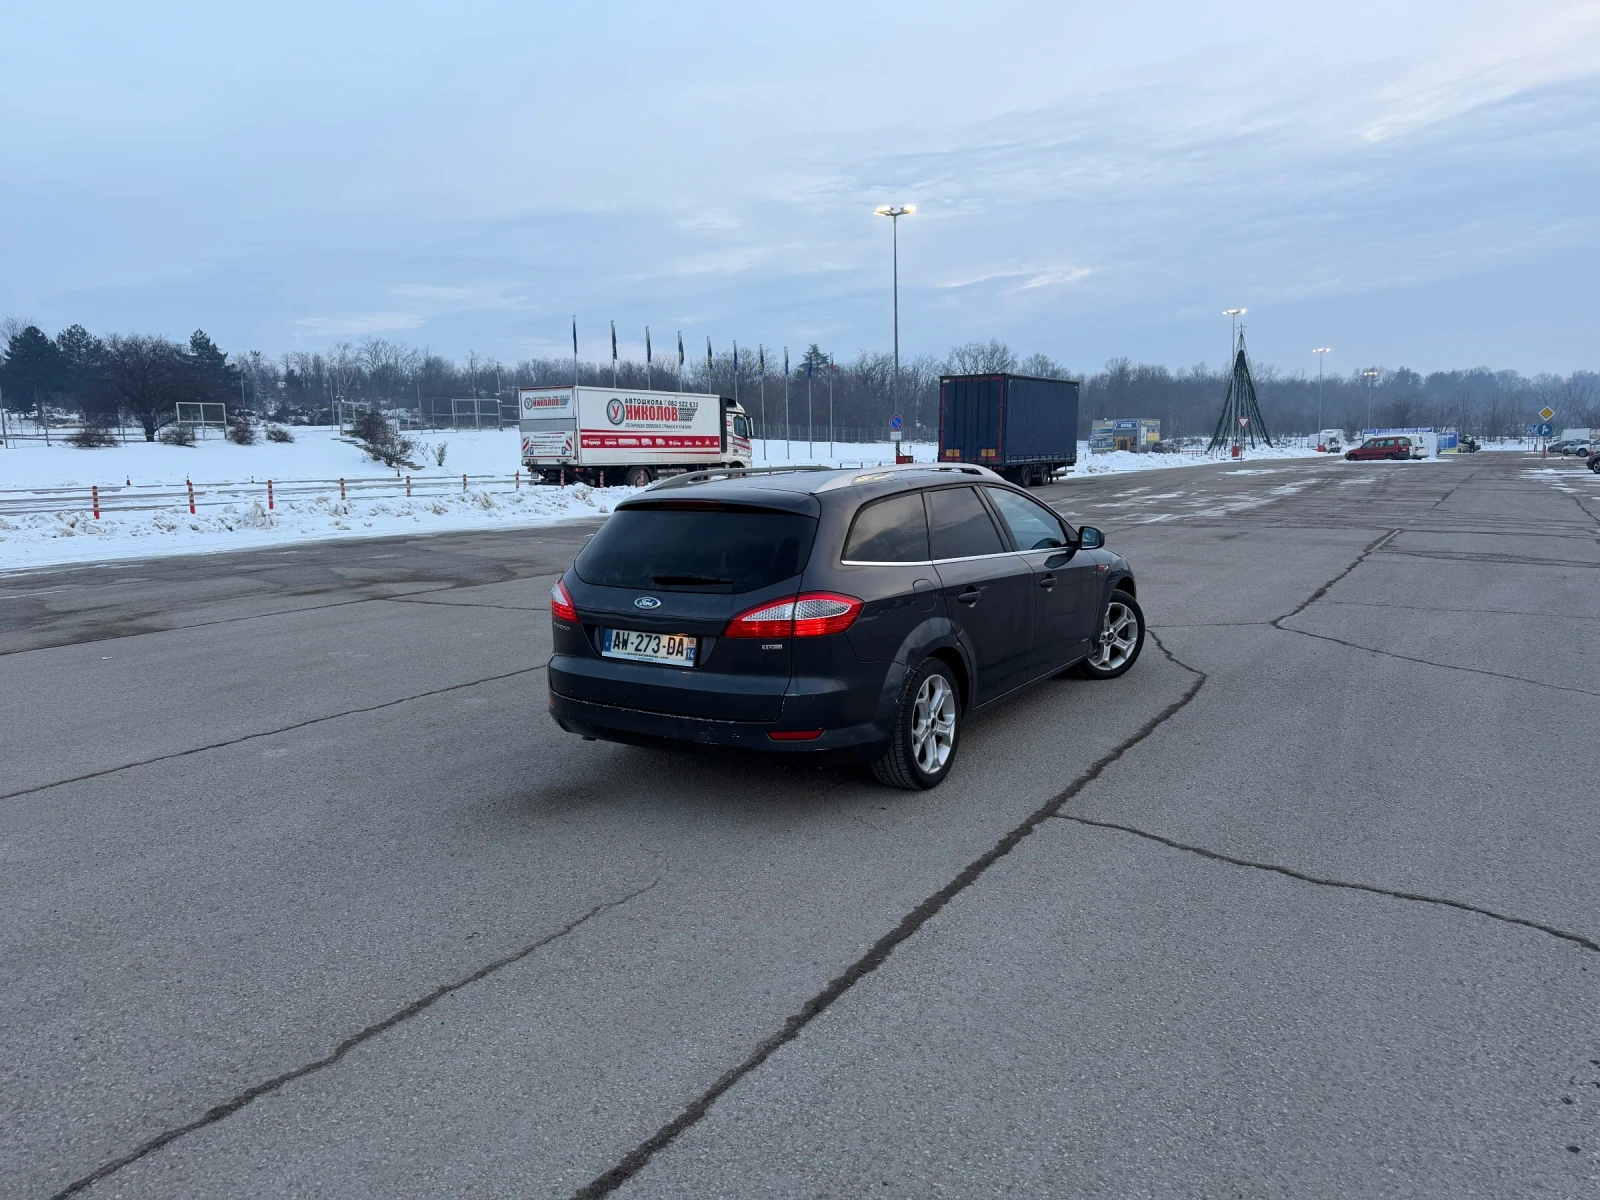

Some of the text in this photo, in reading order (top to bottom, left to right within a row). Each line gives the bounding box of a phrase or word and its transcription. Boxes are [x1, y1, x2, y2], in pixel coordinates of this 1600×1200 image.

[532, 399, 560, 407] НИКОЛОВ
[624, 397, 663, 405] АВТОШКОЛА
[625, 405, 679, 422] НИКОЛОВ
[612, 631, 684, 657] AW-273-DA
[687, 649, 694, 659] 14
